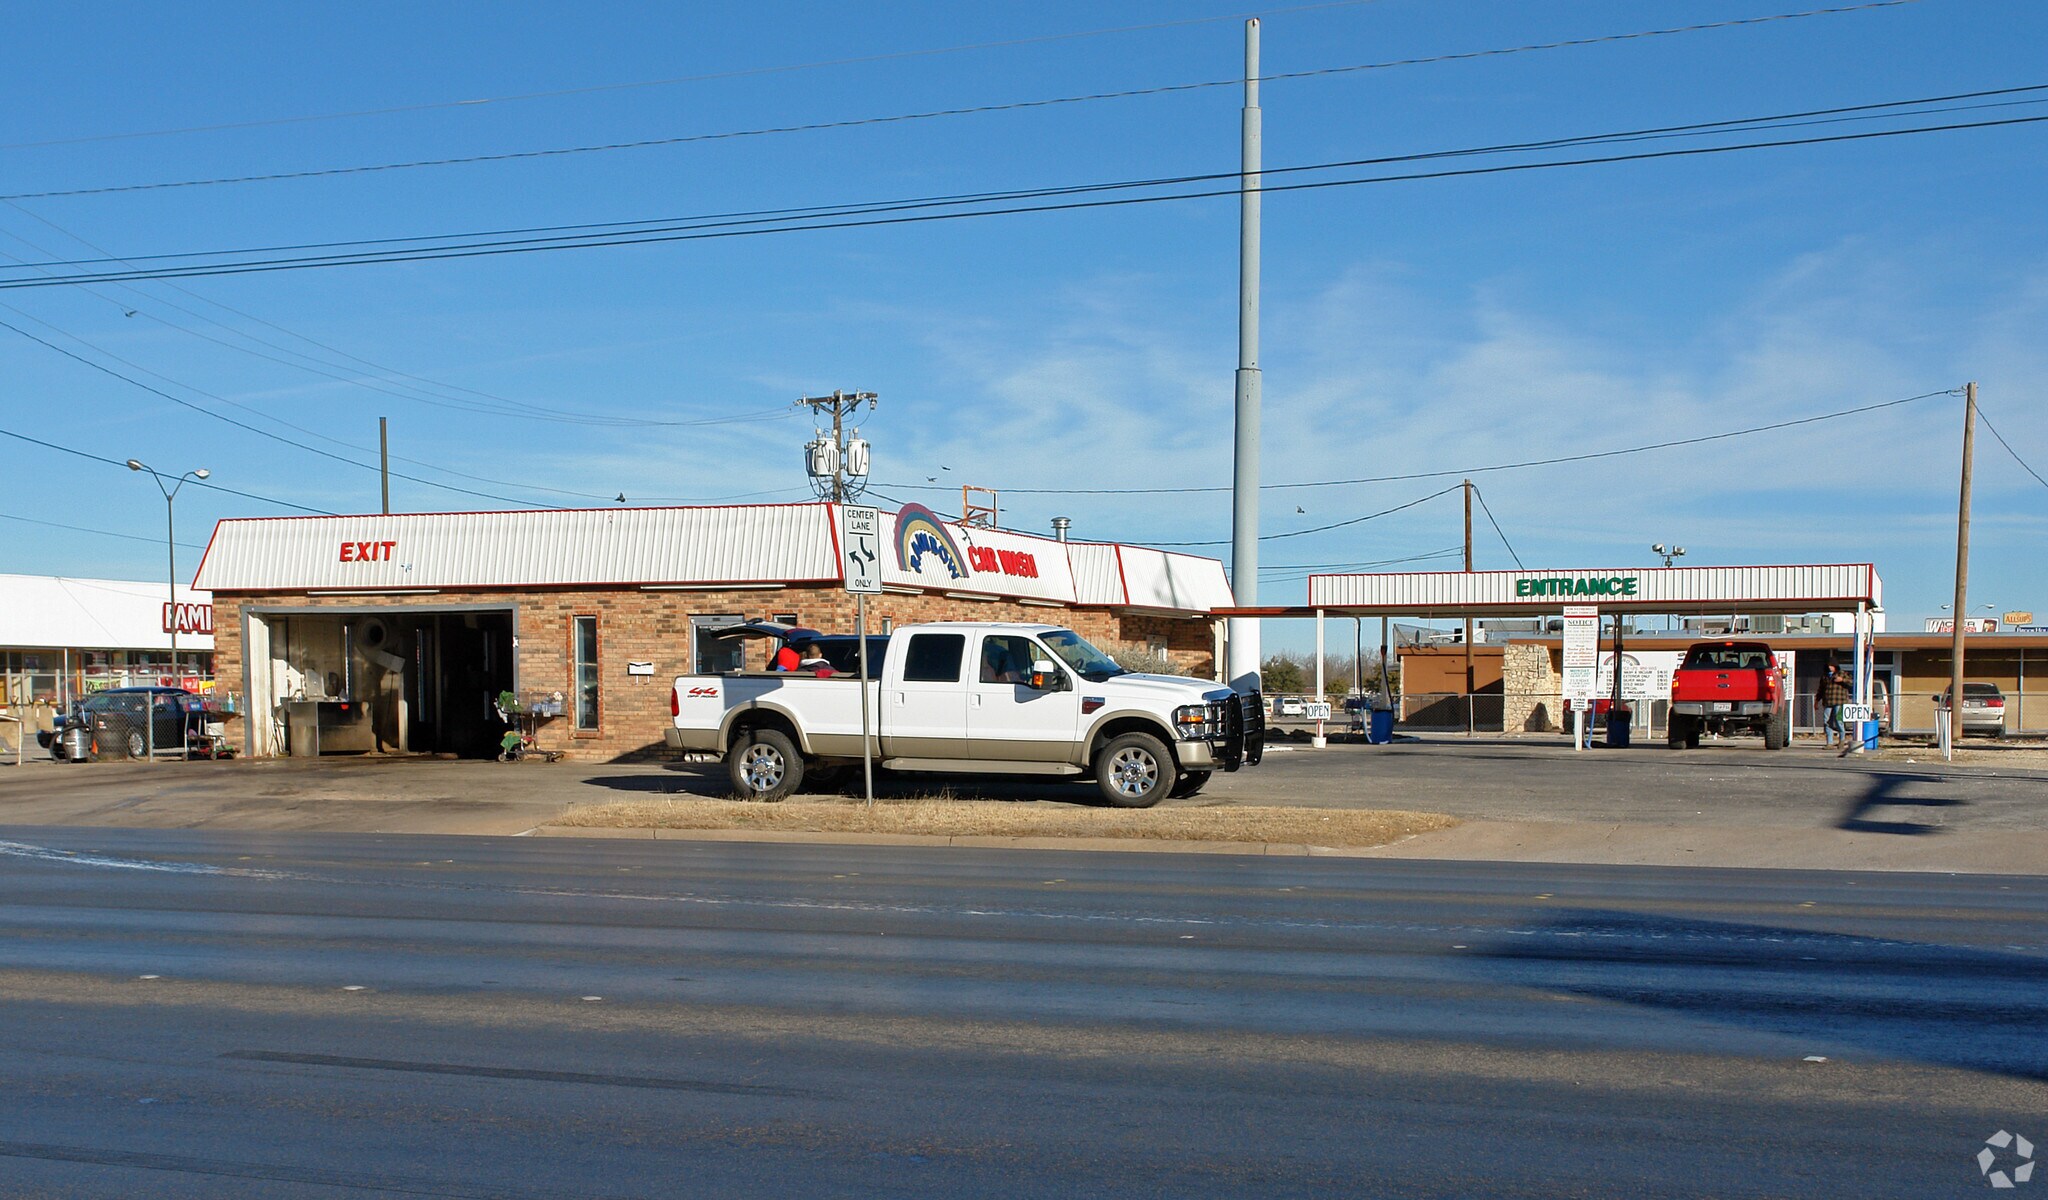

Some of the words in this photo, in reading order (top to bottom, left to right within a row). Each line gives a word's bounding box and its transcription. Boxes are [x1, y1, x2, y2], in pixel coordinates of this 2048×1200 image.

[847, 509, 874, 520] CENTER
[851, 521, 870, 530] LANE
[339, 541, 396, 562] EXIT
[910, 532, 960, 579] RAINBOW
[968, 545, 1000, 573] CAR
[997, 550, 1038, 578] WASH
[855, 578, 872, 588] ONLY
[1516, 577, 1638, 596] ENTRANCE
[1308, 705, 1329, 717] OPEN
[1844, 706, 1870, 719] OPEN
